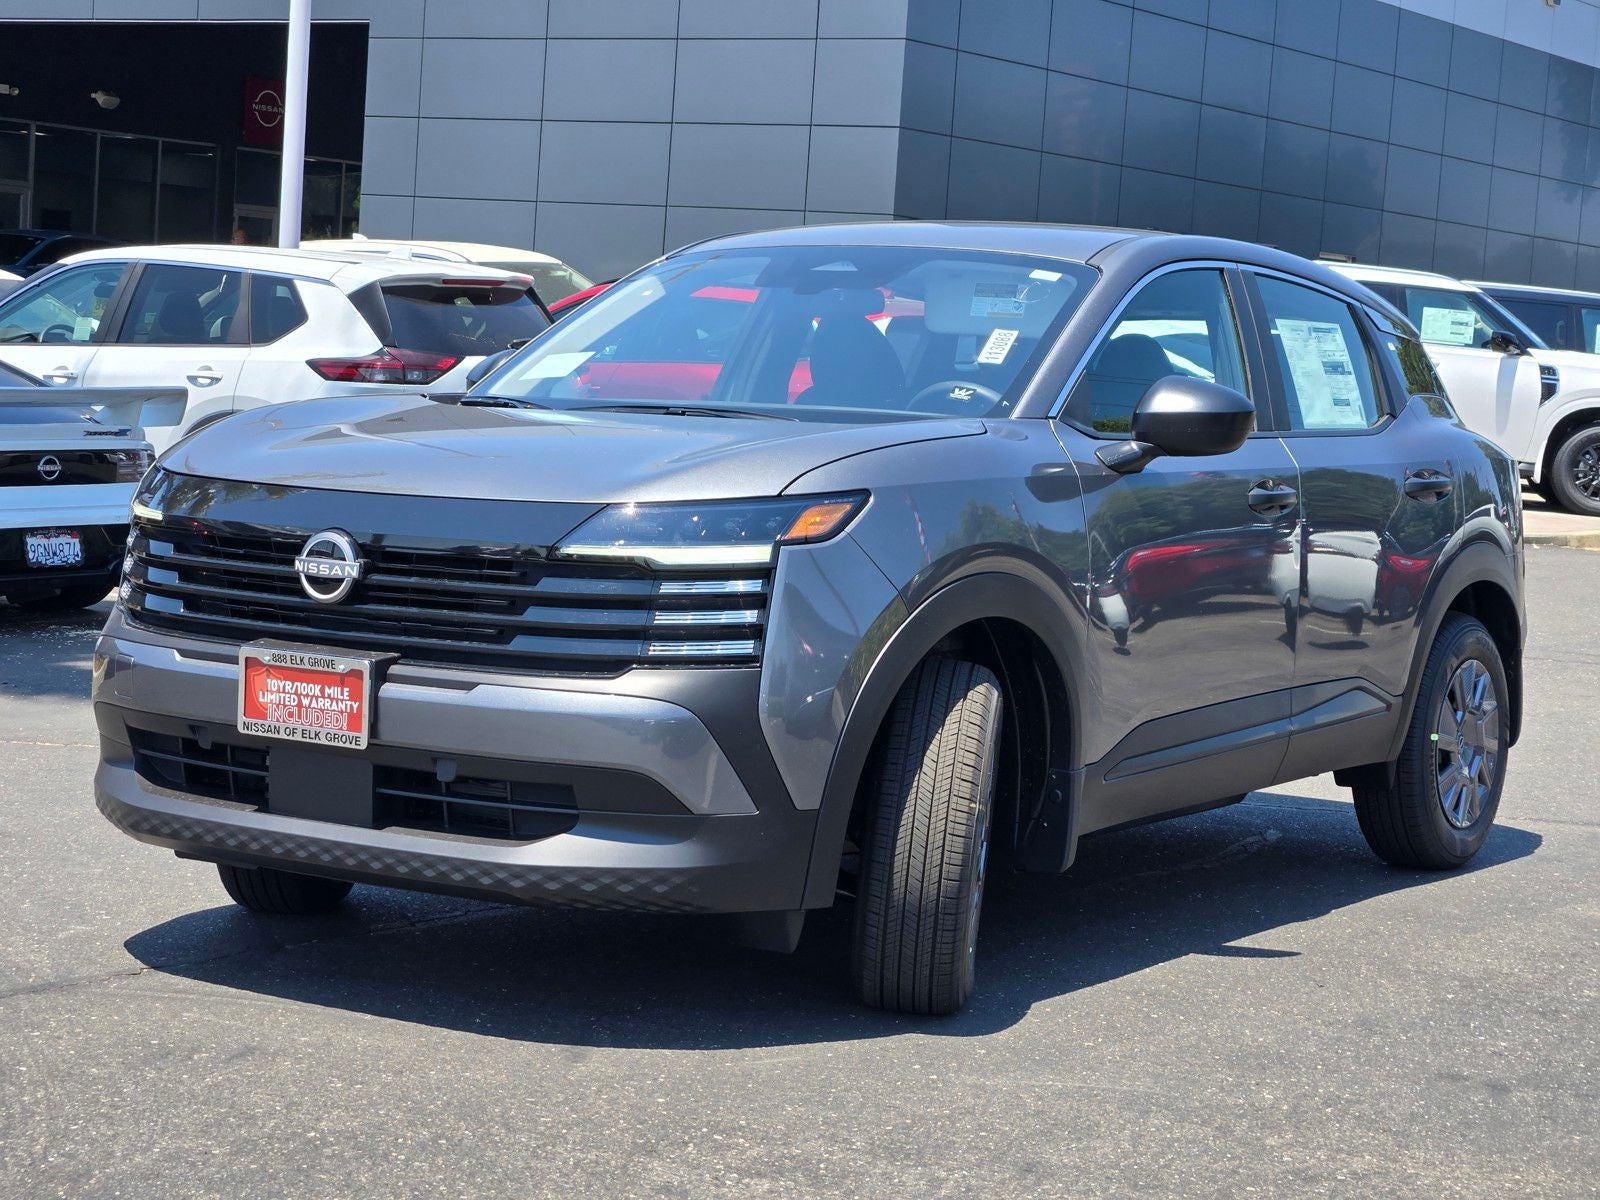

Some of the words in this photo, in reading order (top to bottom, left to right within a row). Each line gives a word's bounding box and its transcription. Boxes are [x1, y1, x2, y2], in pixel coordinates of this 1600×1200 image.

[252, 103, 285, 114] NISSAN
[294, 559, 359, 577] NISSAN
[271, 652, 288, 665] 888
[290, 654, 305, 667] ELK
[308, 656, 337, 670] GROVE
[266, 679, 322, 696] 10YR/100K
[324, 686, 350, 700] MILE
[259, 691, 298, 706] LIMITED
[301, 696, 360, 714] WARRANTY
[267, 703, 348, 730] INCLUDED!
[242, 720, 281, 737] NISSAN
[284, 727, 298, 738] OF
[301, 728, 322, 742] ELK
[325, 733, 362, 747] GROVE
